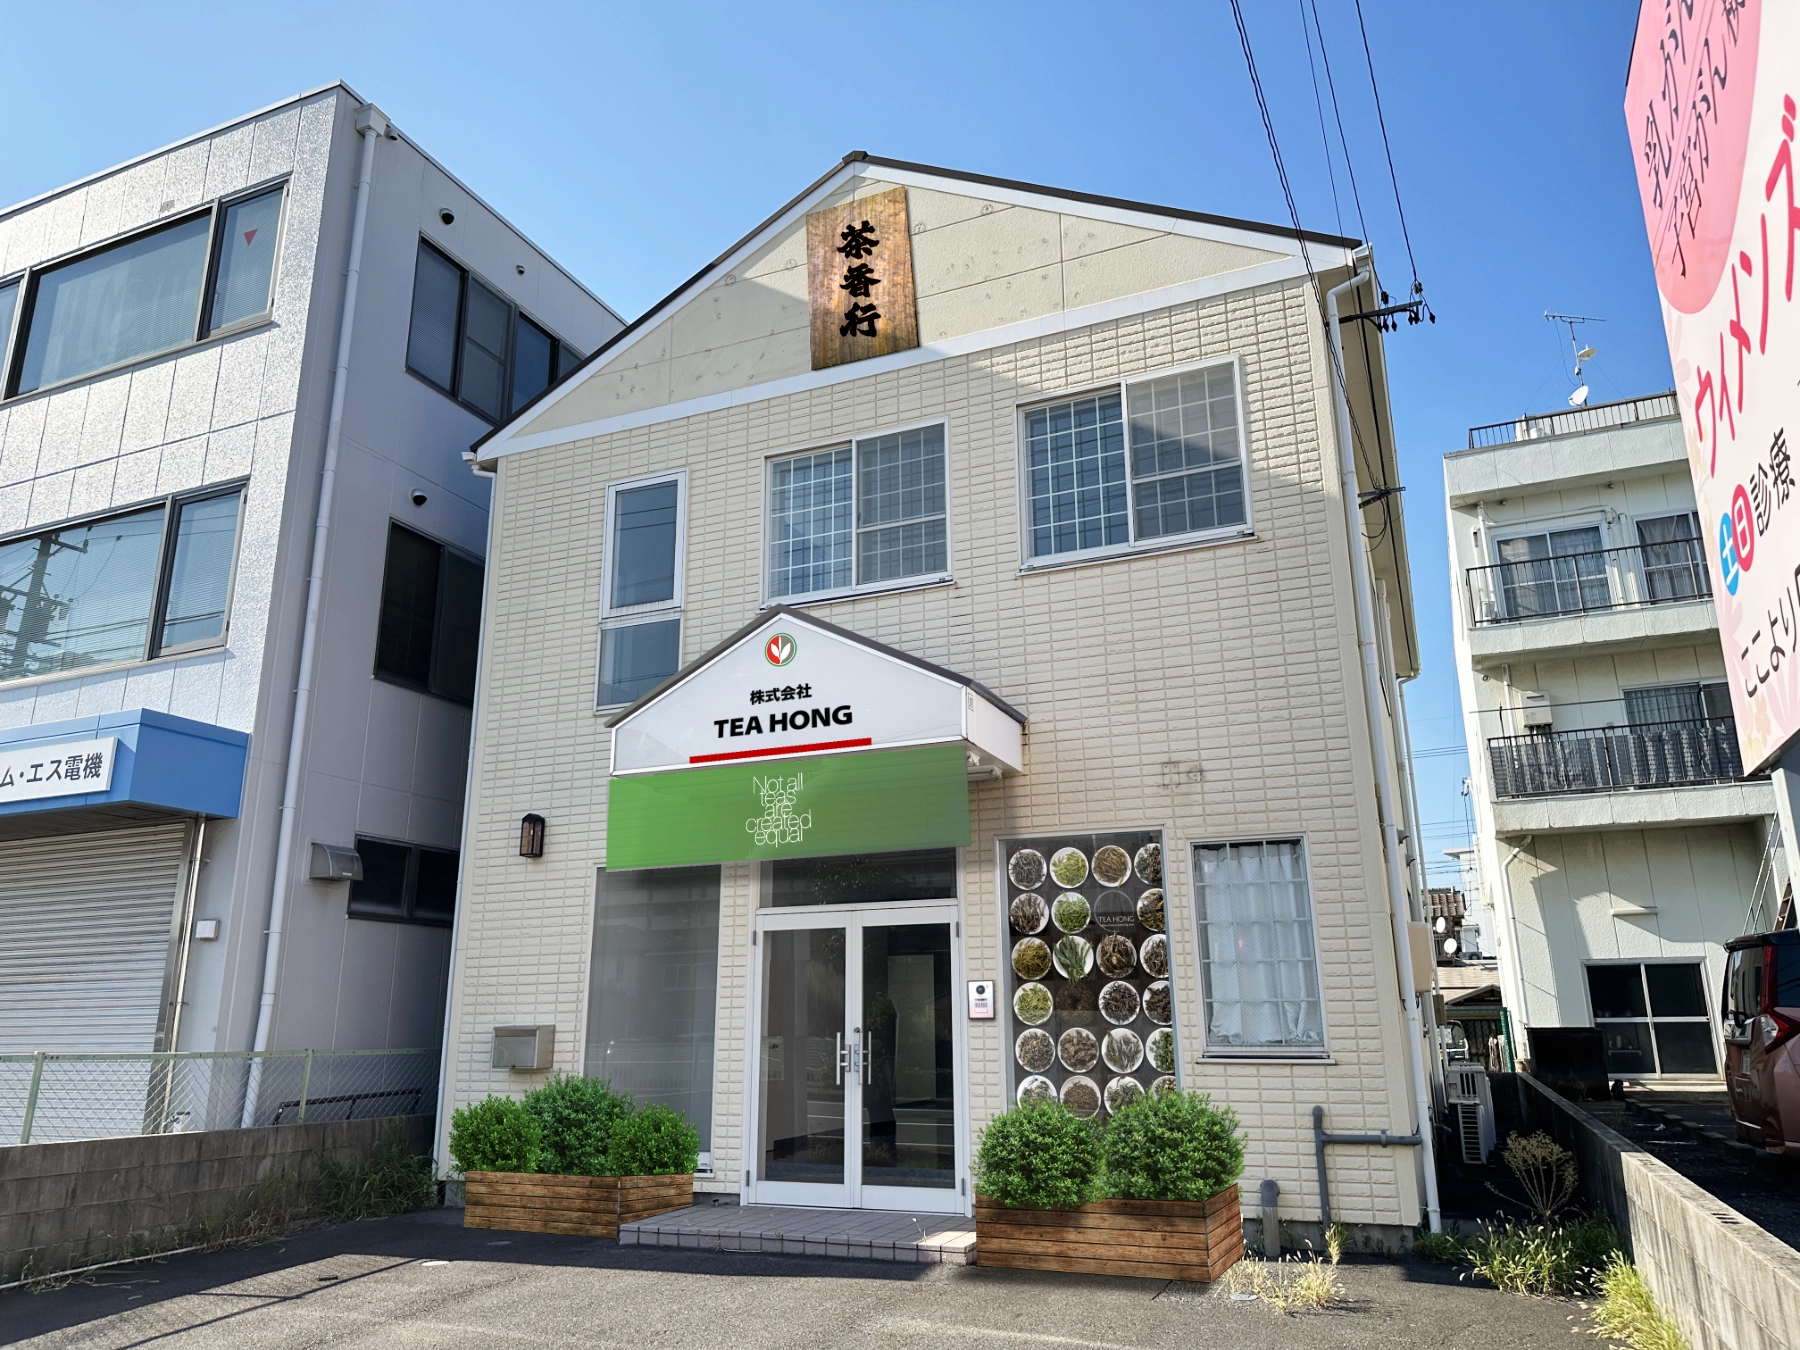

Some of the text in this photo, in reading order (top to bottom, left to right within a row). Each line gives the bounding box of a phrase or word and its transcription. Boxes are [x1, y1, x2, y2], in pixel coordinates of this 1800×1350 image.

[836, 220, 881, 338] 茶香行
[1741, 564, 1800, 698] ここより
[750, 683, 812, 705] 株式会社
[714, 705, 853, 738] TEA HONG
[752, 772, 804, 794] Not all
[759, 789, 797, 806] teas
[745, 809, 812, 833] created
[764, 803, 792, 818] are
[754, 825, 803, 848] equal
